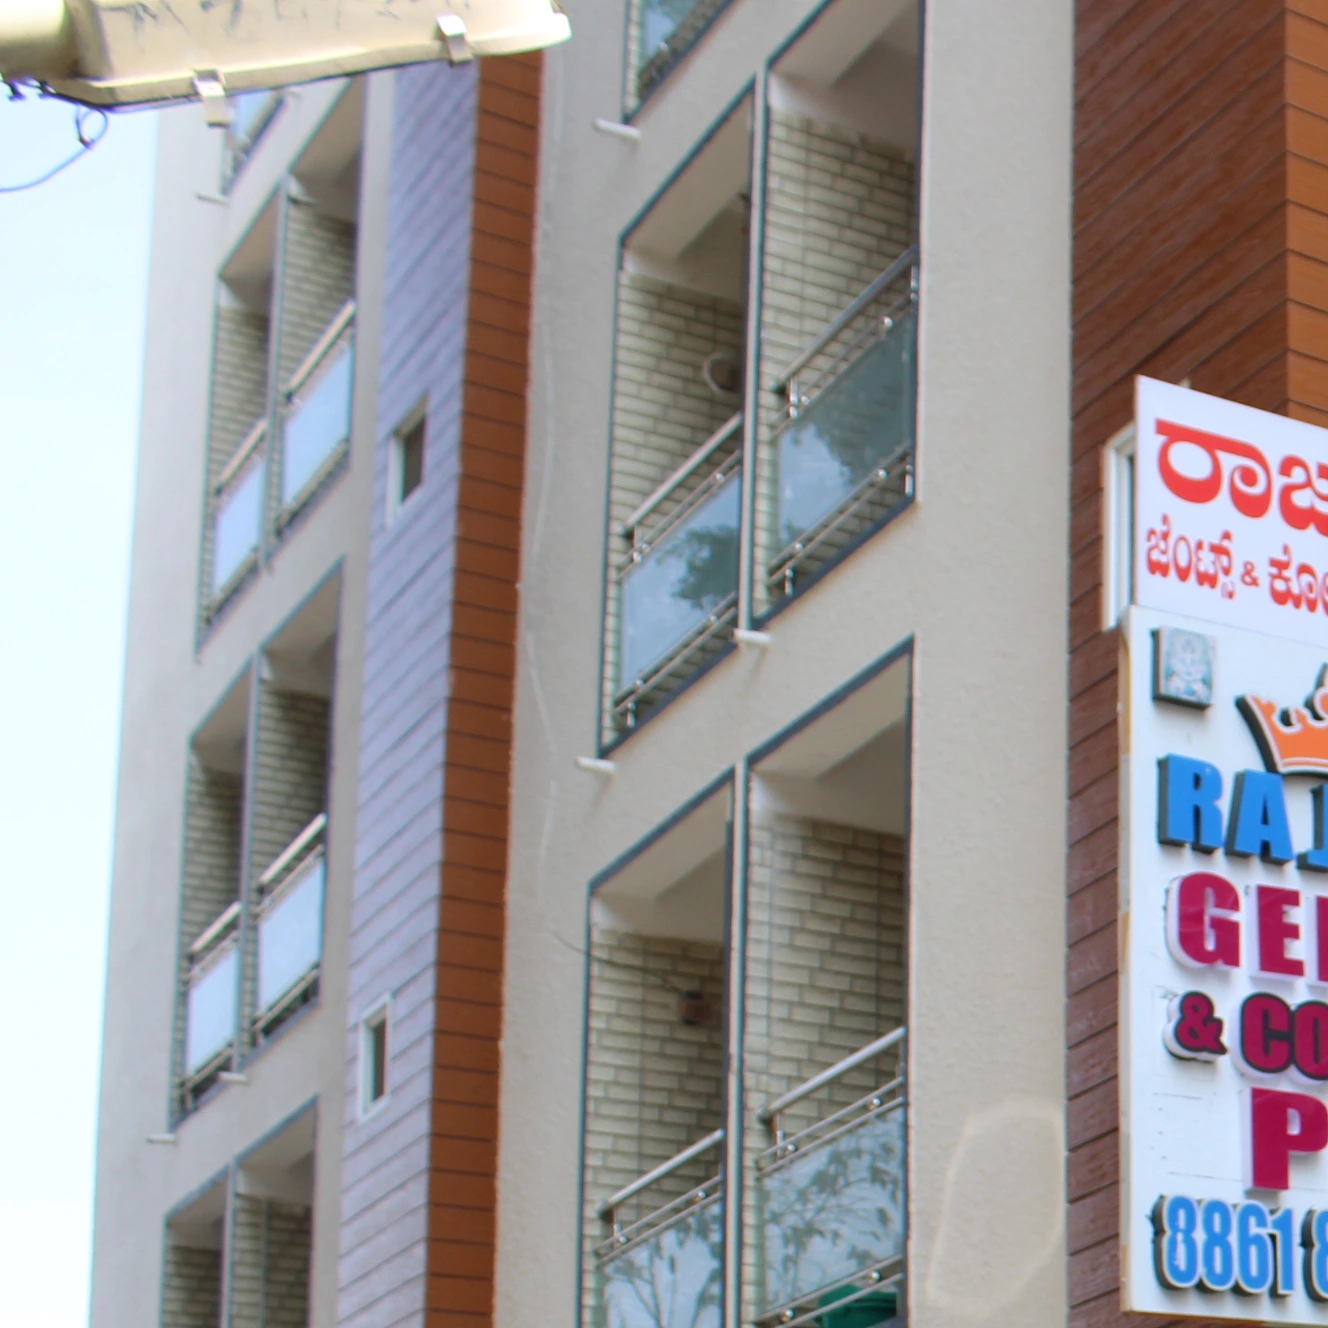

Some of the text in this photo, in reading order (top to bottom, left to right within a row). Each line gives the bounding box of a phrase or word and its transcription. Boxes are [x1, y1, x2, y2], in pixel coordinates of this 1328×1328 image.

[1241, 560, 1260, 587] &
[1166, 991, 1227, 1060] &
[1159, 1194, 1296, 1296] 8861
